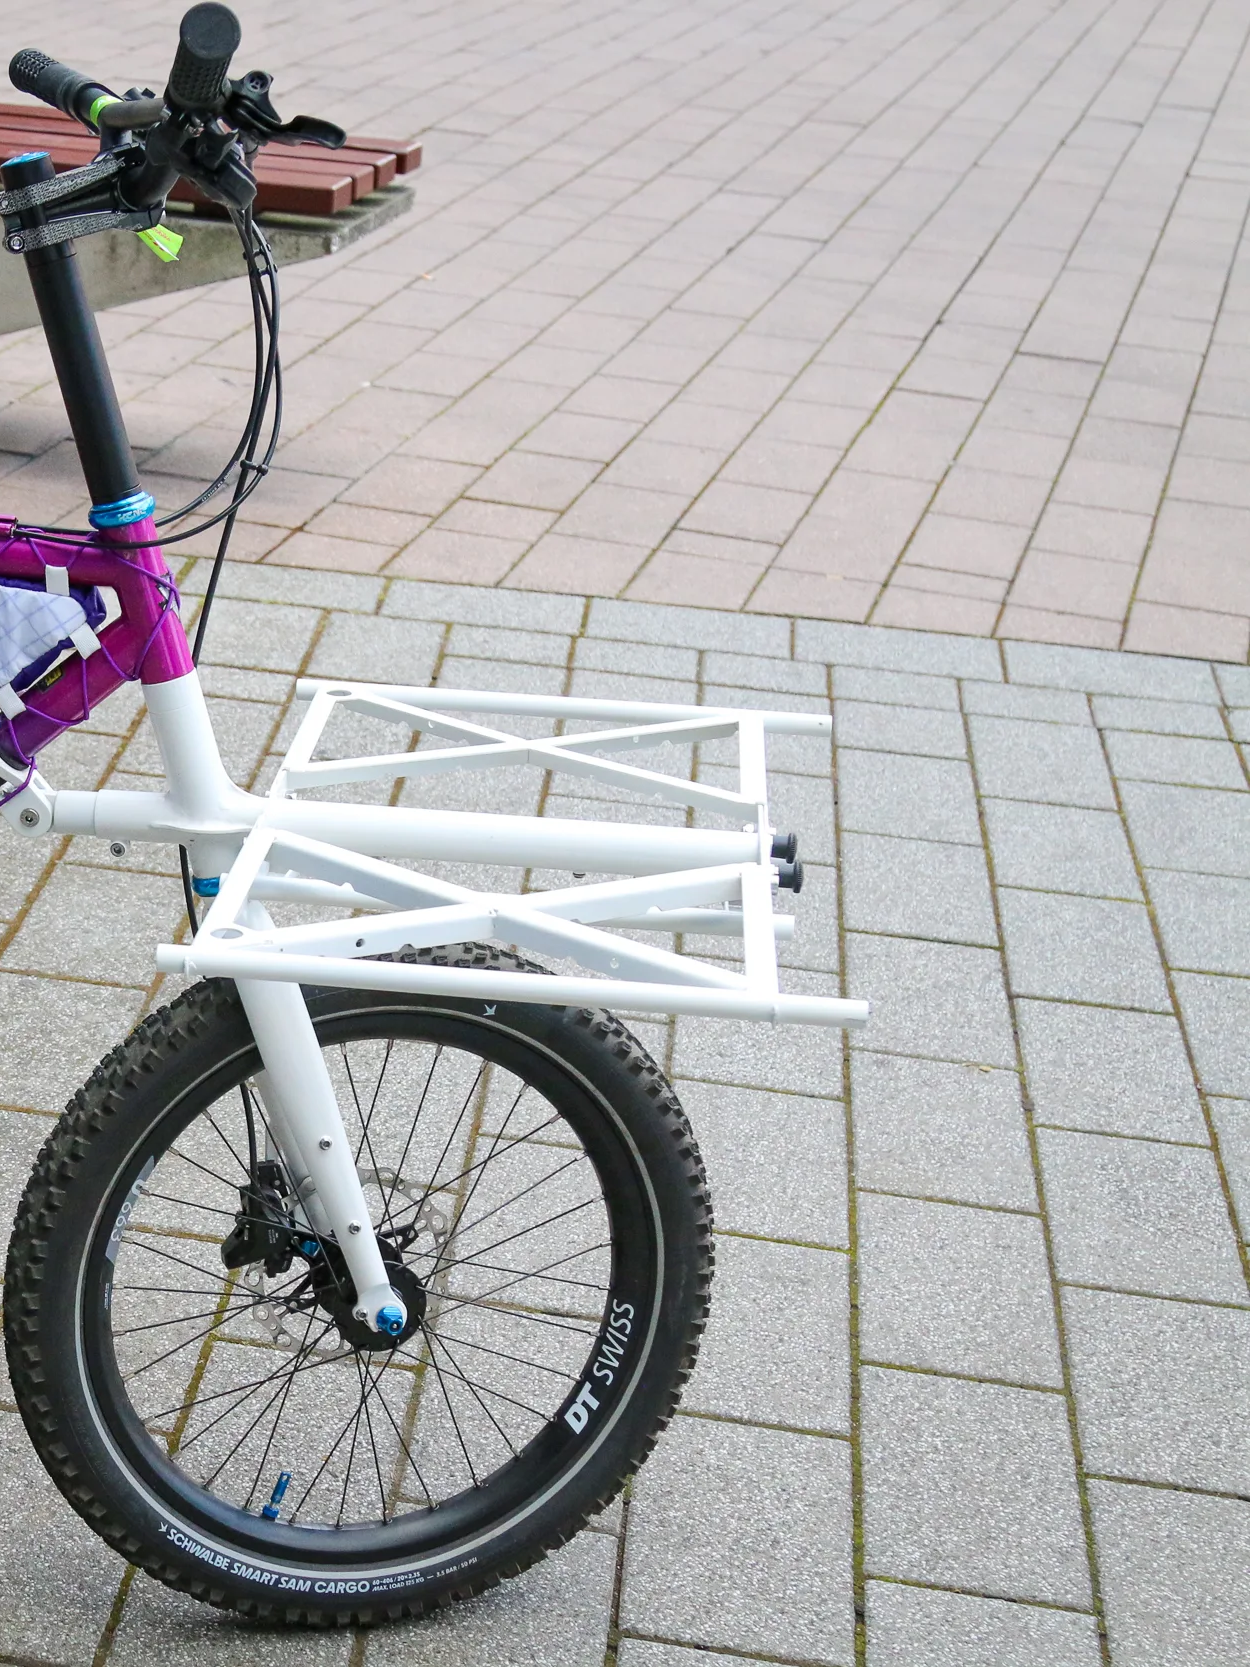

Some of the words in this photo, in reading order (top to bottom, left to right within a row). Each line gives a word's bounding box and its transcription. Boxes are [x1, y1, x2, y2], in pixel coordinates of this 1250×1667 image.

[110, 1201, 132, 1242] 663
[564, 1381, 600, 1435] DT
[593, 1299, 635, 1386] SWISS
[167, 1528, 230, 1571] SCHWALBE
[230, 1562, 279, 1586] SMART
[278, 1577, 312, 1593] SAM
[314, 1581, 370, 1594] CARGO
[445, 1565, 458, 1574] BAR
[468, 1556, 478, 1565] PSI
